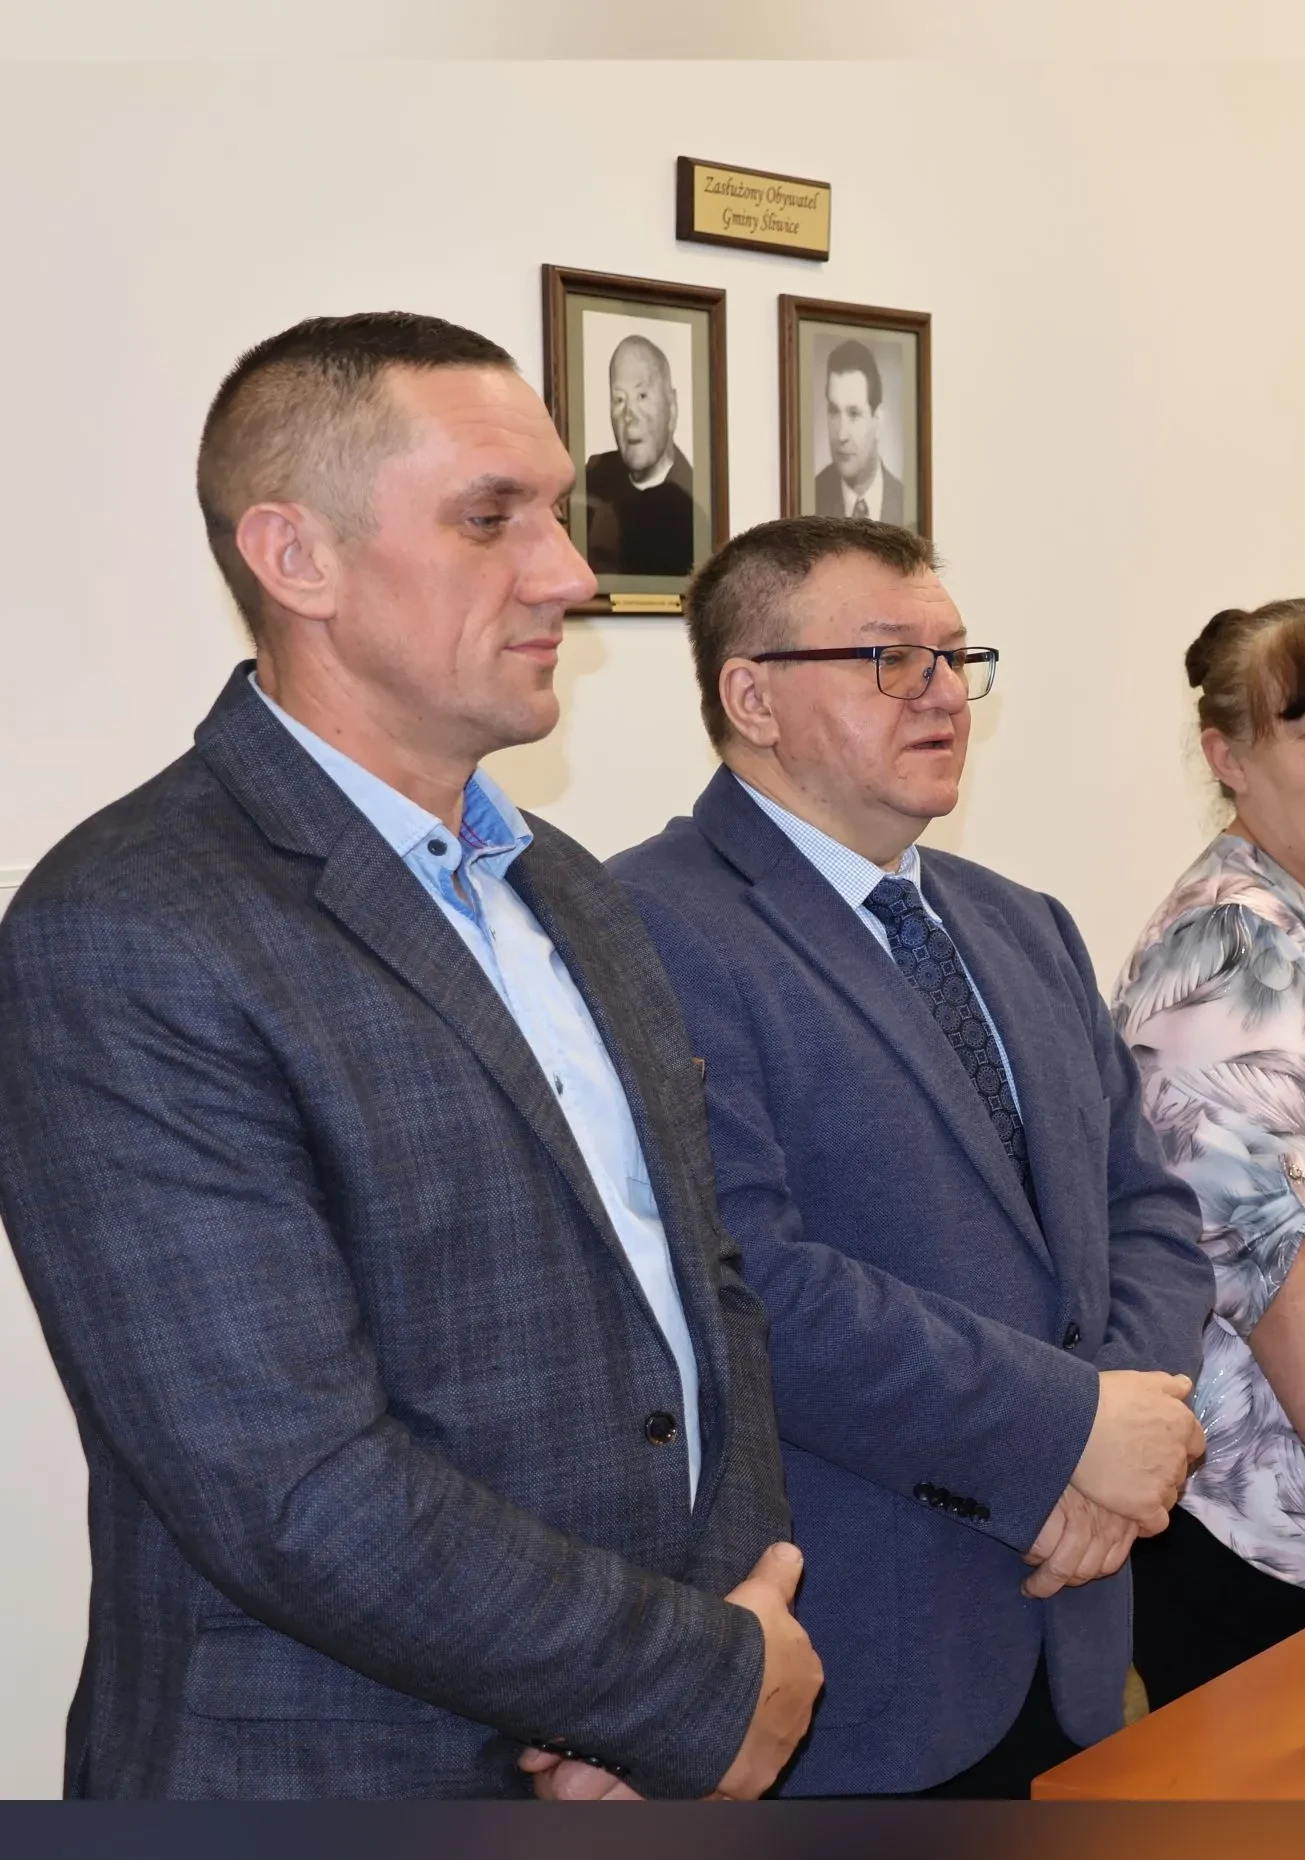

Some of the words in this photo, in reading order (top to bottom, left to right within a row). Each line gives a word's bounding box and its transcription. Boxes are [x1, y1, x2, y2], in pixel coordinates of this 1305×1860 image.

[704, 176, 765, 207] Zasłużony
[767, 185, 819, 210] Obywatel
[722, 207, 759, 234] Gminy
[760, 208, 800, 235] Śliwice
